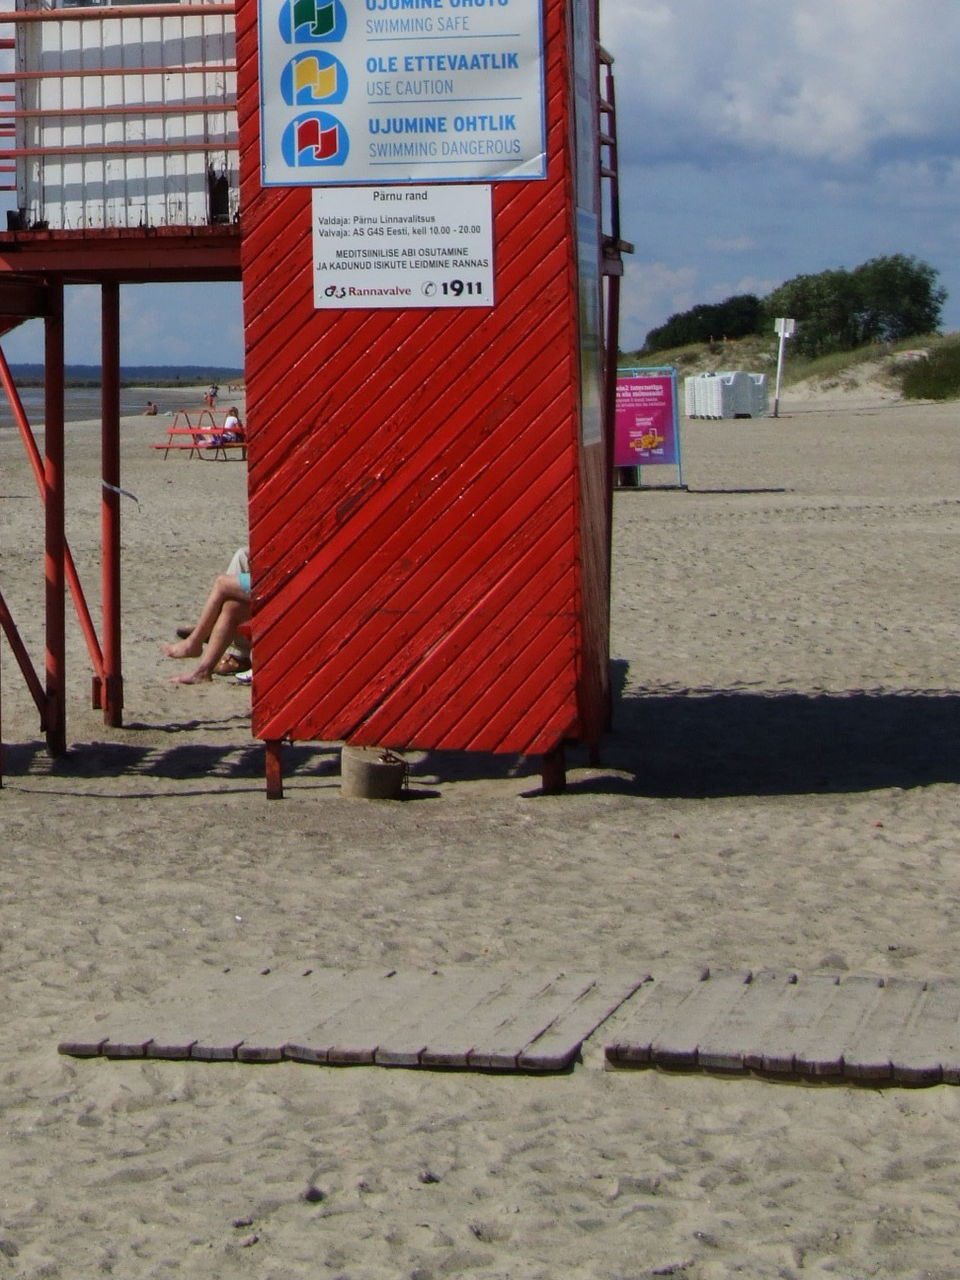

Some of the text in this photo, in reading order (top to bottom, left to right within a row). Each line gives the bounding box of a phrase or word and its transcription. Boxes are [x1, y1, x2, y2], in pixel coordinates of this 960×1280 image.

[366, 16, 470, 34] SWIMMING SAFE
[366, 52, 519, 73] OLE ETTEVAATLIK
[366, 79, 454, 97] USE CAUTION
[368, 114, 517, 134] UJUMINE OHTLIK
[368, 138, 521, 158] SWIMMING DANGEROUS
[373, 191, 429, 201] Pärnu rand
[318, 214, 436, 226] Valdaja: Pärnu Linnavalitsus
[318, 228, 351, 238] Valvaja:
[353, 227, 365, 236] AS
[367, 227, 384, 236] G4S
[386, 226, 410, 236] Eesti,
[412, 226, 428, 235] kell
[429, 226, 451, 235] 10.00
[458, 225, 482, 234] 20.00
[336, 247, 469, 258] MEDITSIINILISE ABI OSUTAMINE
[317, 258, 489, 271] JA KADUNUD ISIKUTE LEIDMINE RANNAS
[348, 286, 412, 296] Rannavalve
[441, 279, 483, 297] 1911
